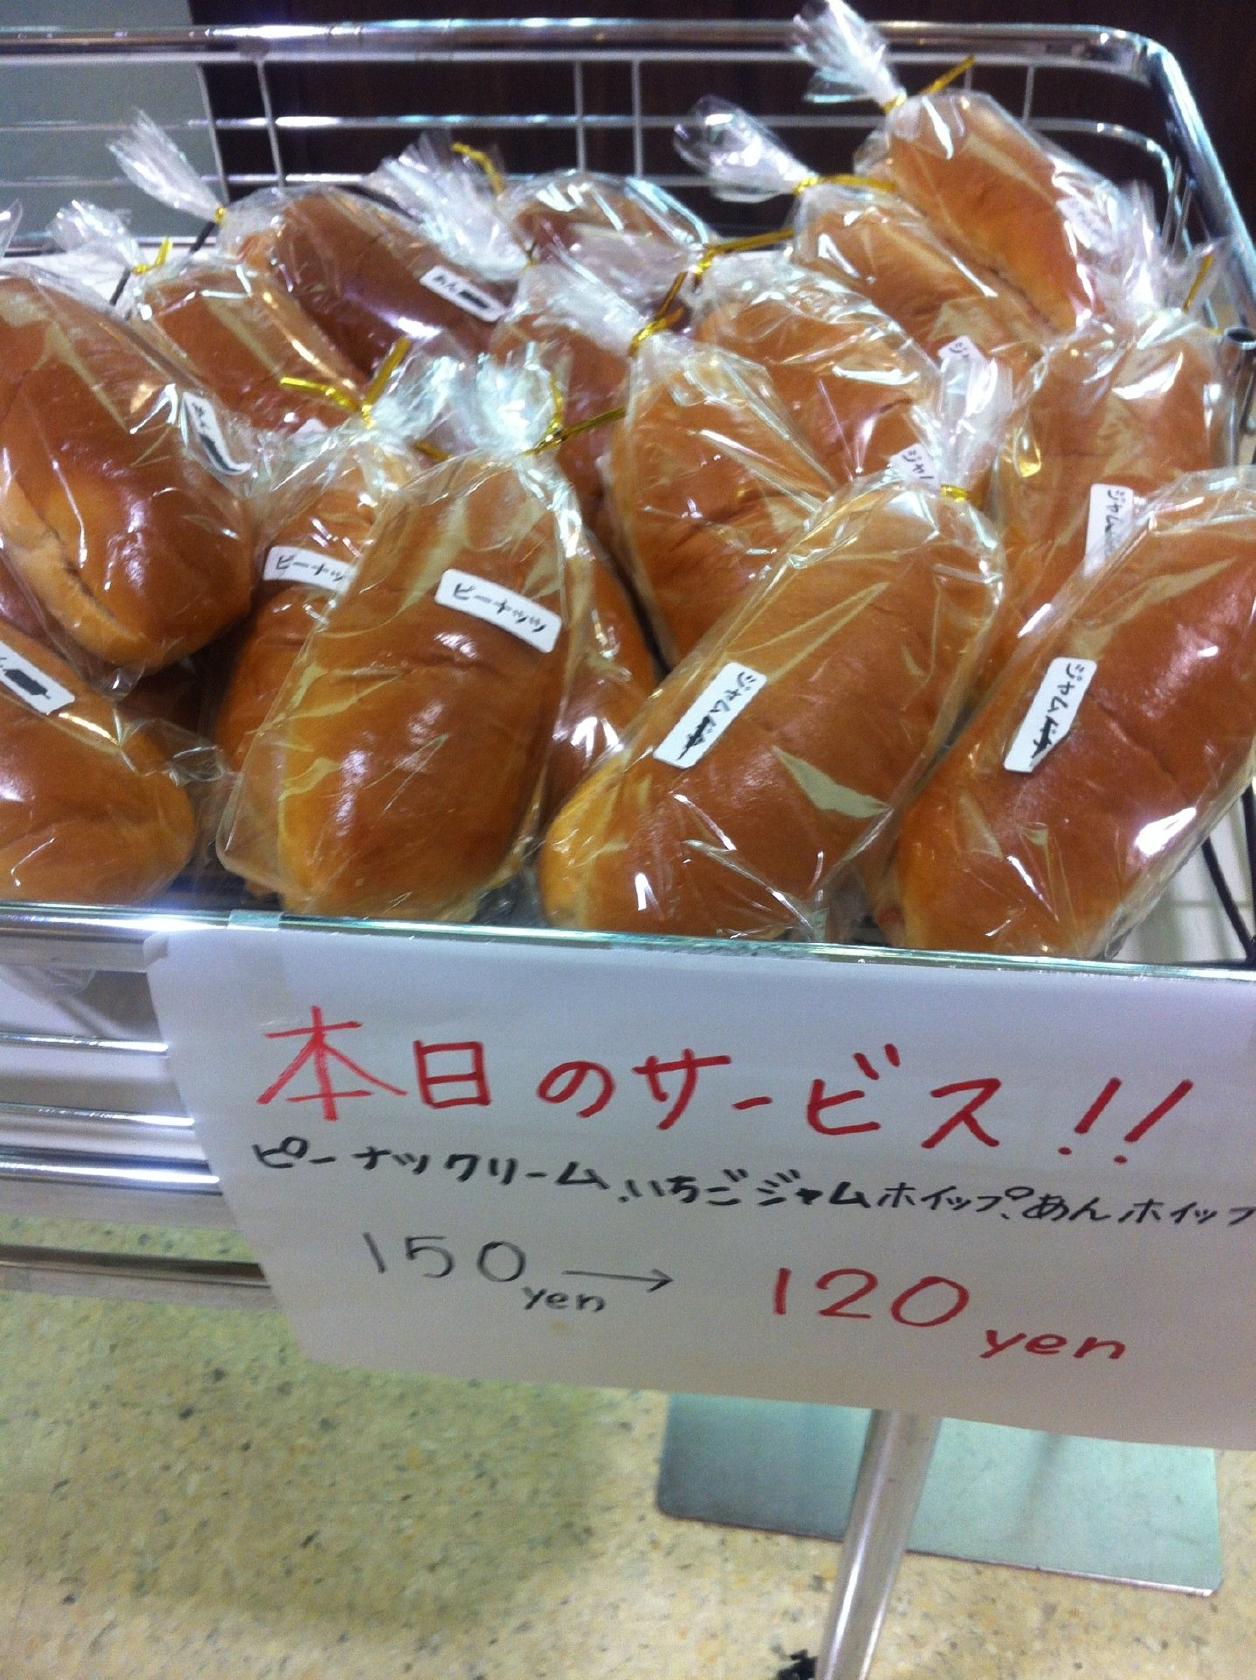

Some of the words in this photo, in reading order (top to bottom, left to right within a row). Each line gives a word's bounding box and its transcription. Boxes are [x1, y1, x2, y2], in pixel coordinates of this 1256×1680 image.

[362, 1231, 527, 1284] 150
[520, 1285, 607, 1314] yen
[772, 1267, 971, 1329] 120
[979, 1328, 1127, 1361] yen
